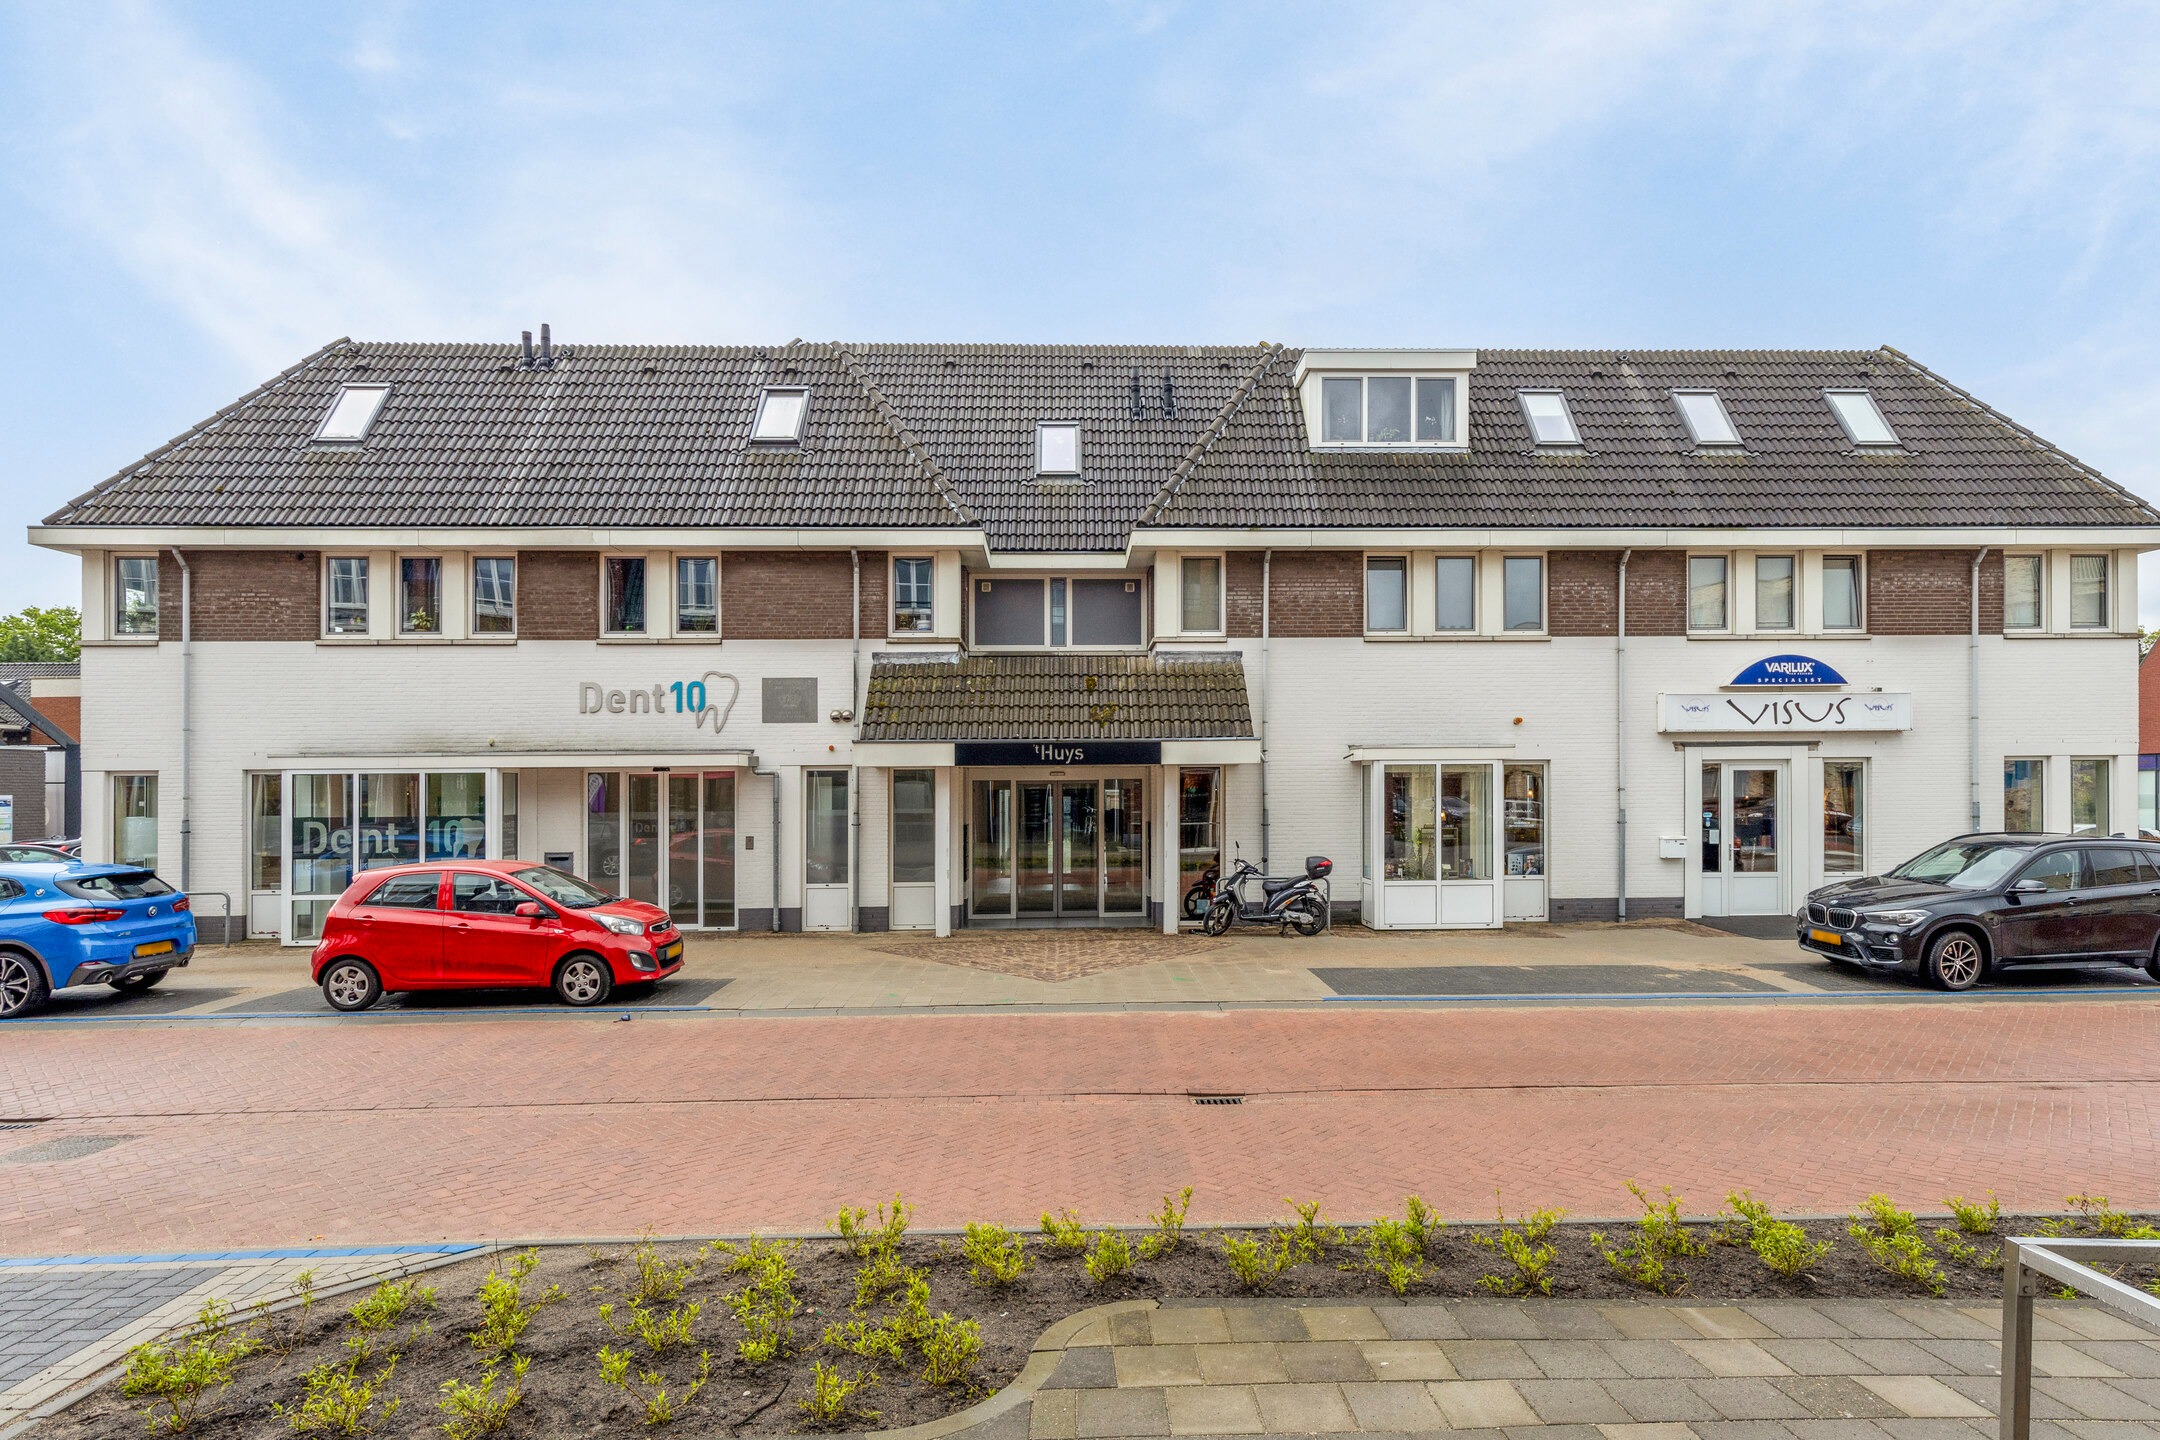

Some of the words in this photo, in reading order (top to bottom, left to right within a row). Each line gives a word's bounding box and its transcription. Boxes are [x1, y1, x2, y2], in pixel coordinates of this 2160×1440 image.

[579, 681, 665, 714] Dent
[669, 680, 706, 713] 10
[1726, 697, 1852, 725] VISUS
[1041, 744, 1084, 764] Huys
[302, 821, 400, 855] Dent
[427, 819, 464, 853] 10
